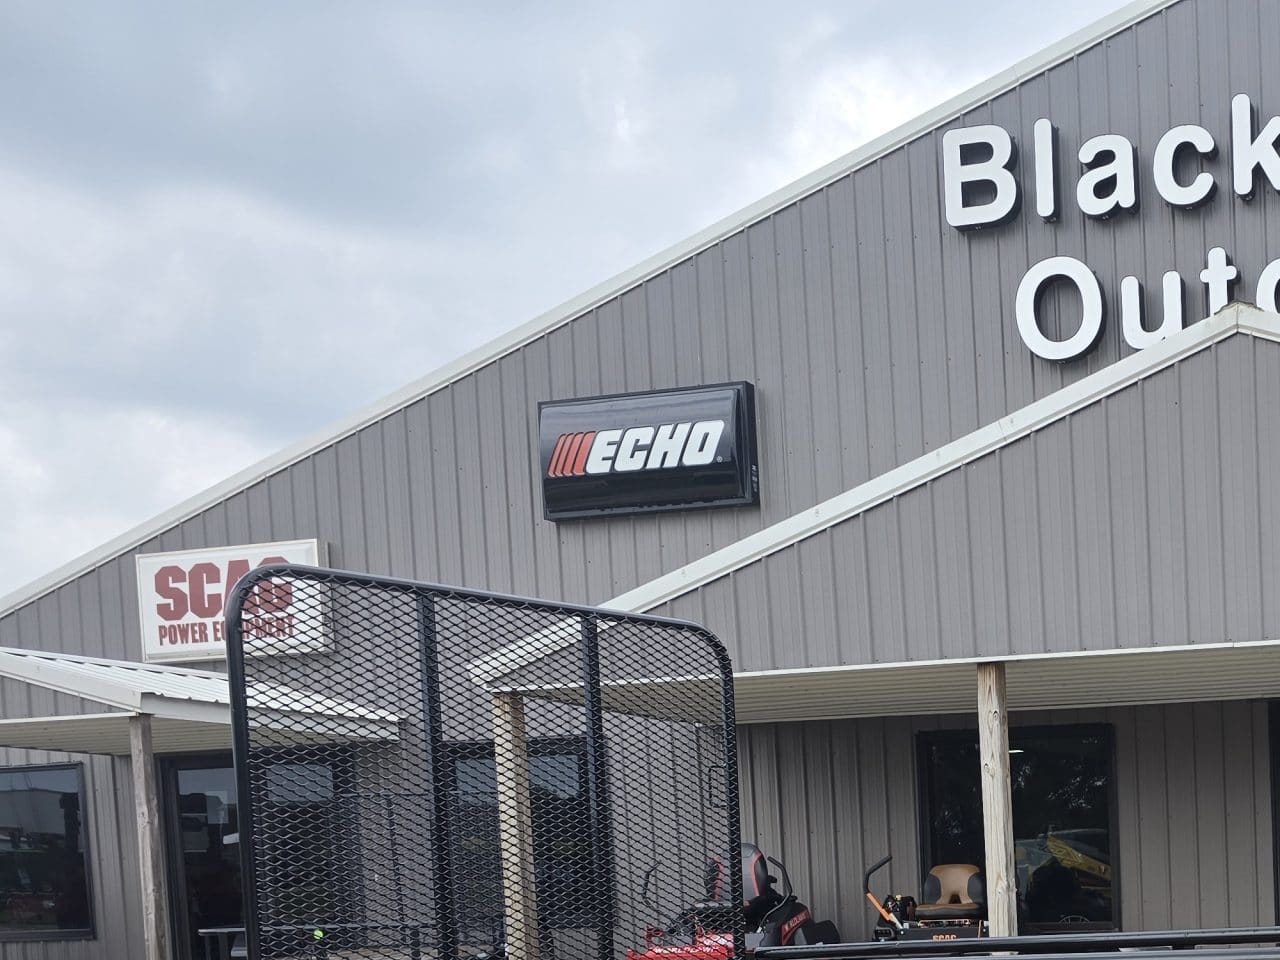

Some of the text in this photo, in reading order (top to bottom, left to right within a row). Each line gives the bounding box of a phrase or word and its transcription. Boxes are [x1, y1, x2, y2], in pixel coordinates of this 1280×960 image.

[585, 419, 725, 475] ECHO
[154, 556, 293, 622] SCAG
[158, 622, 209, 646] POWER
